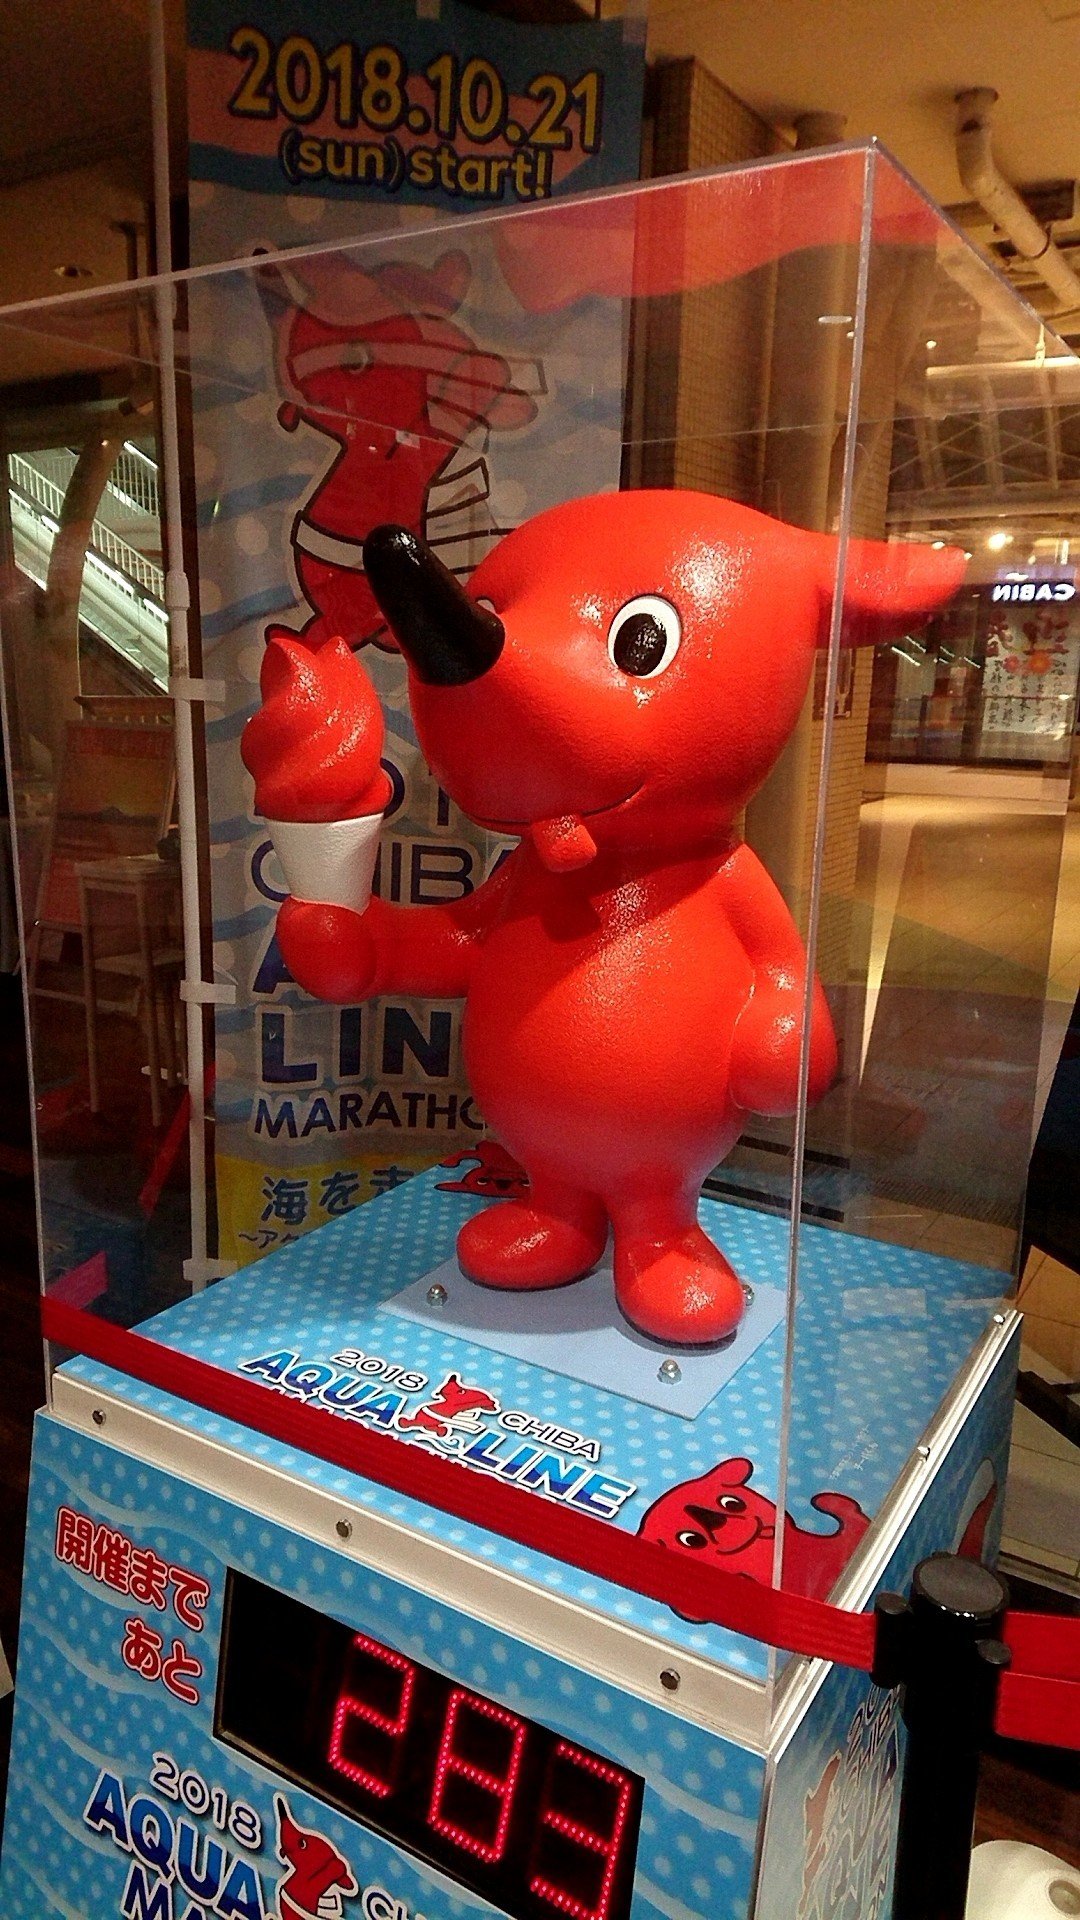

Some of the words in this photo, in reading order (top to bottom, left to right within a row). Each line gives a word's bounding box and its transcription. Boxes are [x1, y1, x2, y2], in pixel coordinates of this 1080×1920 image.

[230, 27, 602, 150] 2018.10.21
[335, 1349, 428, 1391] 2018
[239, 1350, 406, 1429] AQUA
[461, 1429, 636, 1518] LINE
[498, 1411, 601, 1462] CHIBA
[56, 1506, 209, 1632] 開催まで
[122, 1618, 203, 1704] あと
[151, 1752, 263, 1850] 2018
[327, 1633, 632, 1920] 283
[84, 1769, 267, 1920] AQUA
